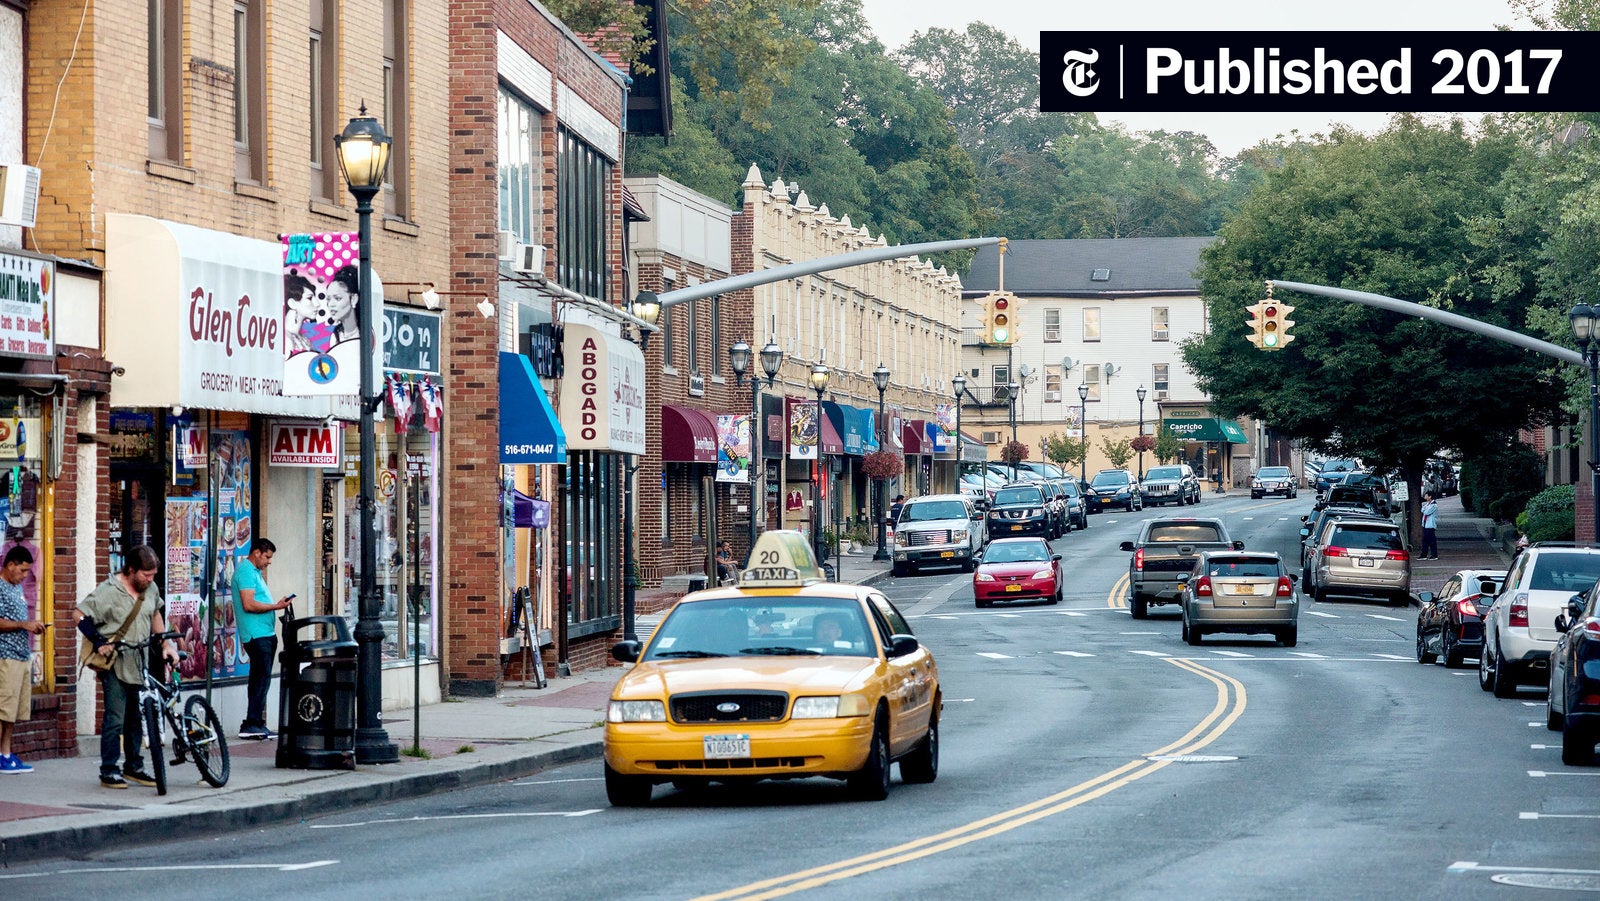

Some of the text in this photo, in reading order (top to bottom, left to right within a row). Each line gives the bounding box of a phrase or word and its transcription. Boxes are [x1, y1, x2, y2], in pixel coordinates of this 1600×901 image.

[285, 240, 316, 265] ART
[190, 287, 277, 357] Glen Cove
[201, 372, 283, 396] GROCERY MEAT PRODU
[581, 338, 597, 440] ABOGADO
[274, 428, 332, 453] ATM
[505, 444, 553, 454] 516-671-0447
[272, 455, 335, 464] AVAILABLE INSIDE
[760, 550, 780, 564] 20
[756, 568, 785, 579] TAXI
